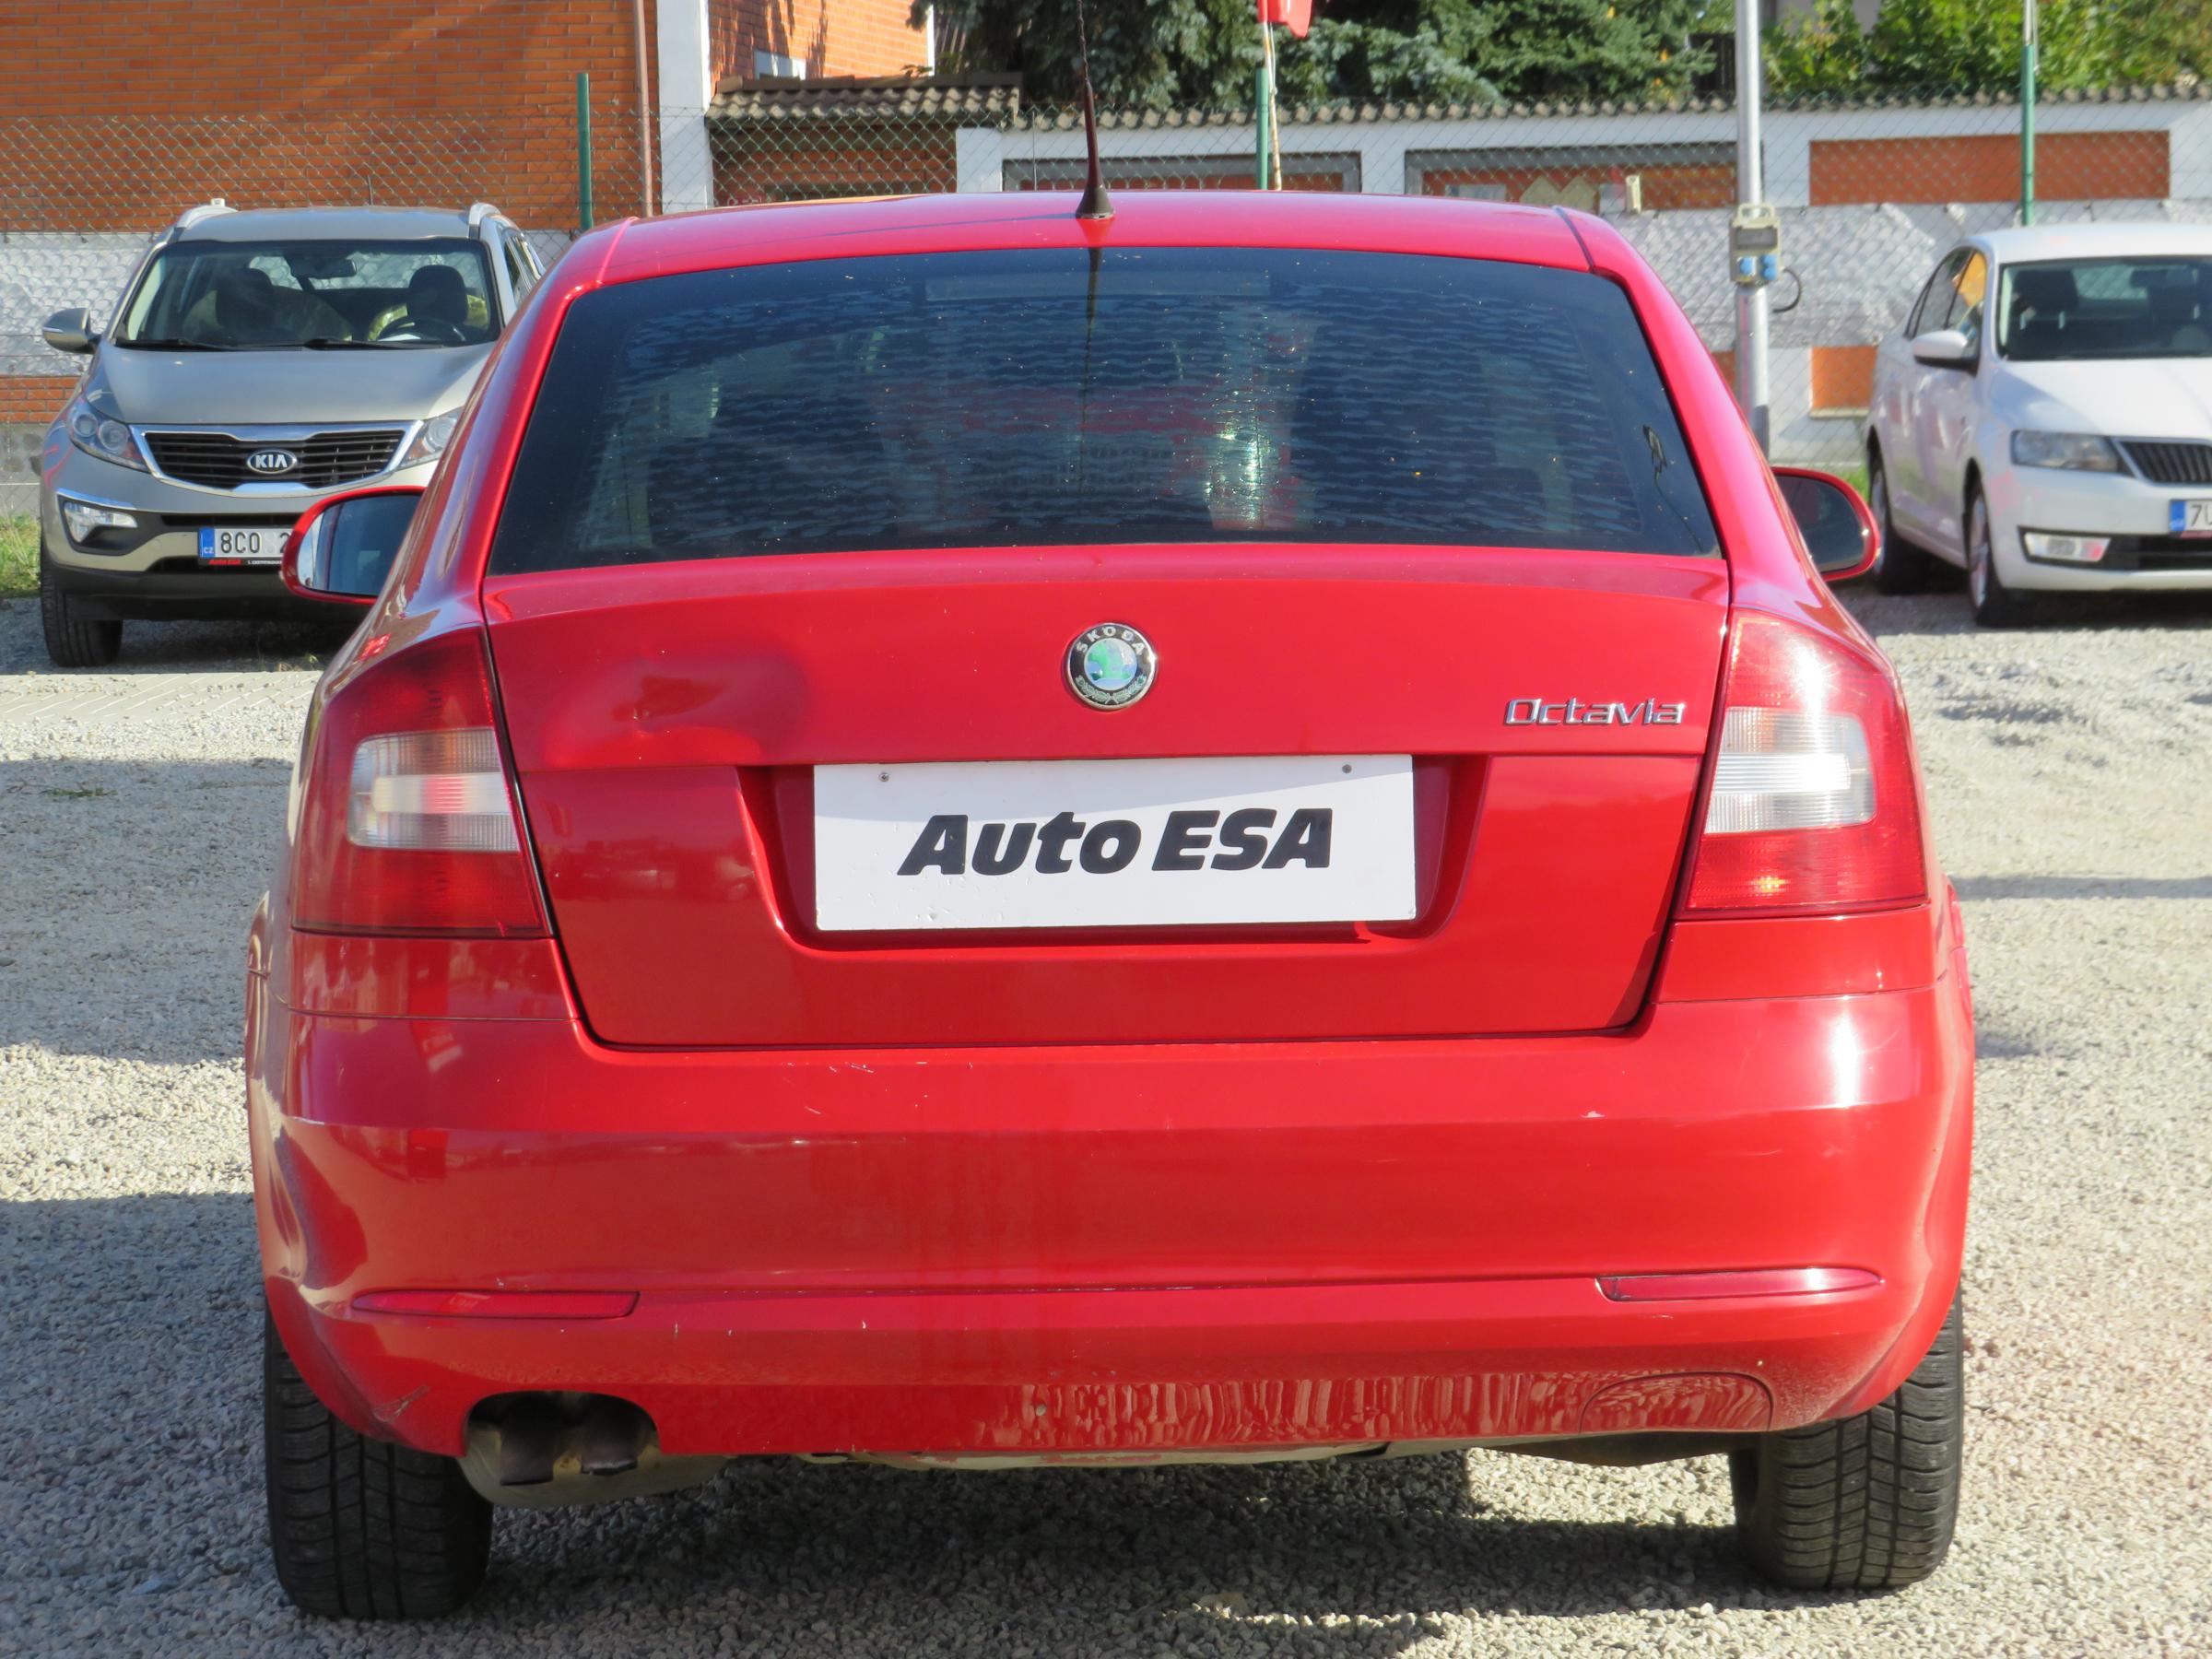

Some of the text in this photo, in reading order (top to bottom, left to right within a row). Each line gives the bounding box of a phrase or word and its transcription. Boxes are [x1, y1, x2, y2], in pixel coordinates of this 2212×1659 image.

[255, 453, 288, 468] KIA
[1503, 697, 1686, 724] Octavia
[897, 808, 1333, 876] Auto ESA
